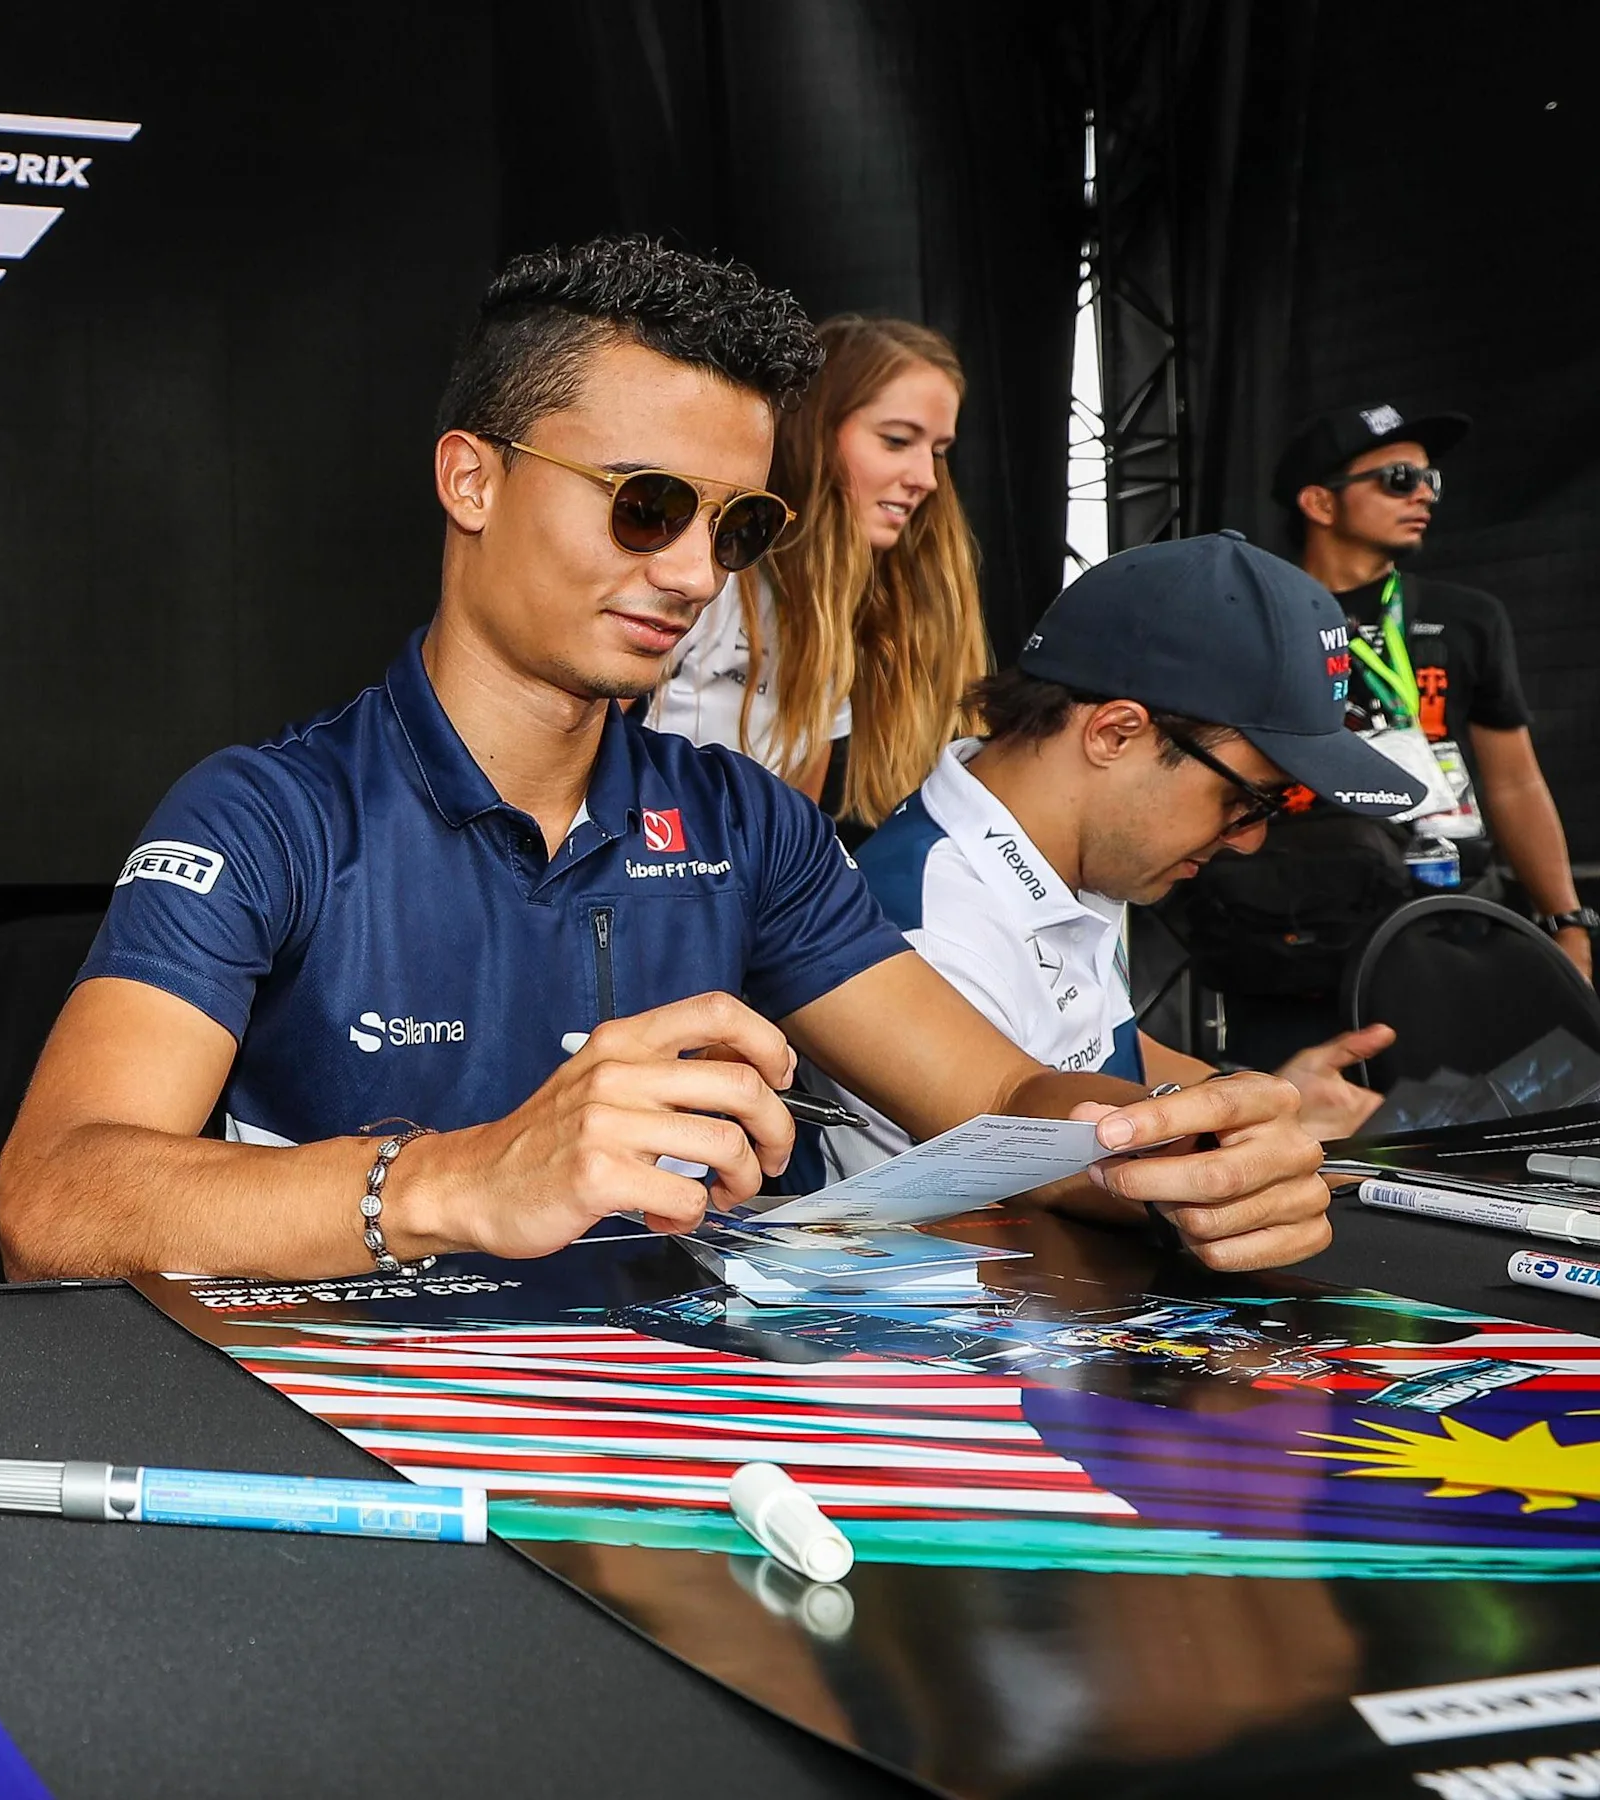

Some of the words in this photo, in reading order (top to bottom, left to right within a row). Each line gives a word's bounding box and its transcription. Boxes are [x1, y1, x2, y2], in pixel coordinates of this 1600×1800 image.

[1356, 790, 1413, 806] randstad
[688, 859, 731, 876] Team
[998, 839, 1047, 901] Rexona
[387, 1015, 465, 1047] Silanna
[198, 1292, 308, 1308] 2222
[312, 1286, 418, 1303] 8778
